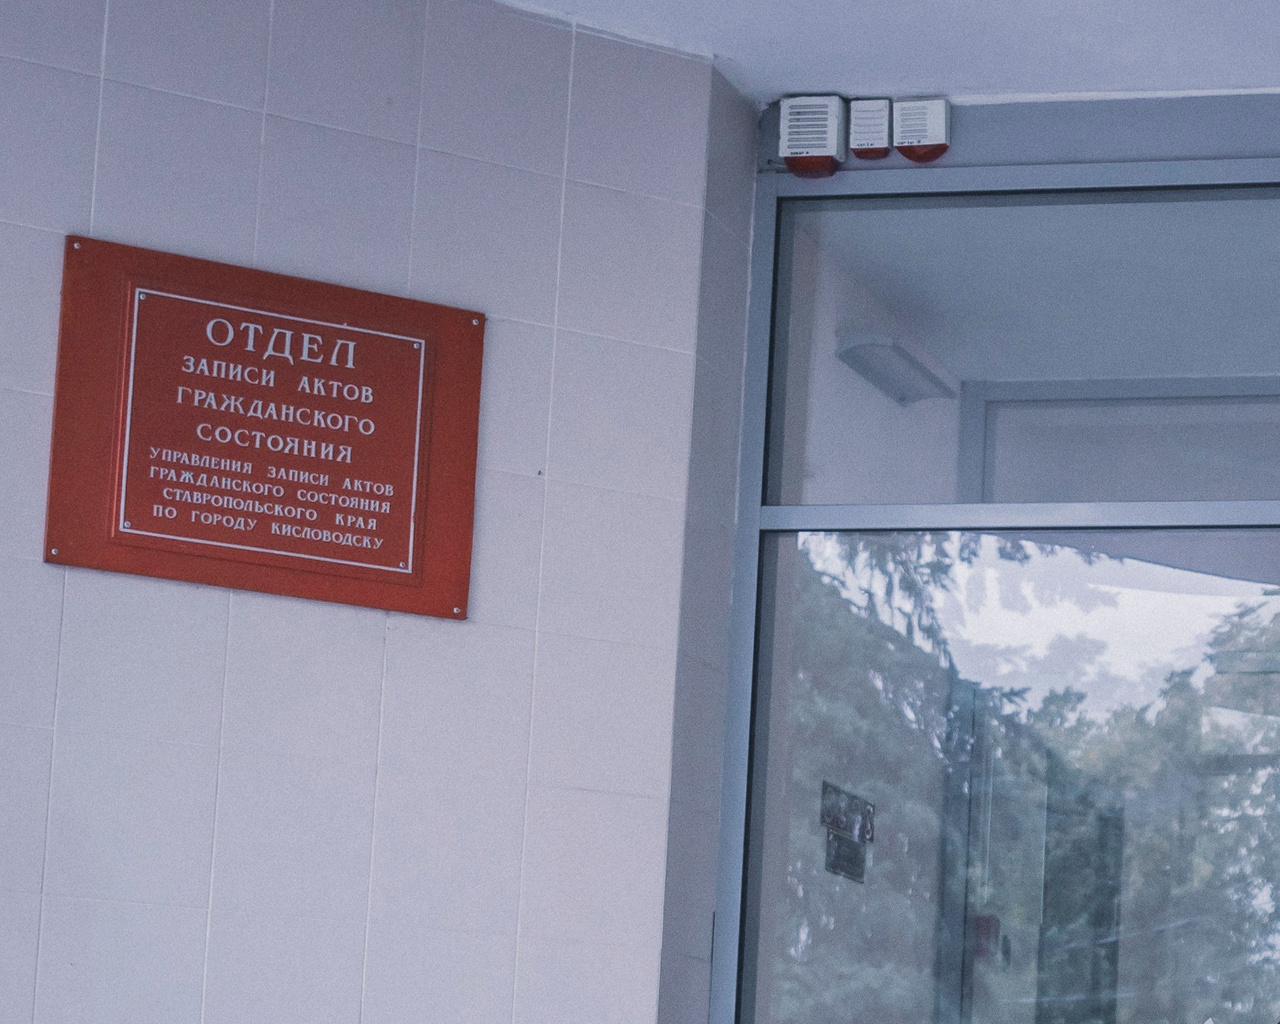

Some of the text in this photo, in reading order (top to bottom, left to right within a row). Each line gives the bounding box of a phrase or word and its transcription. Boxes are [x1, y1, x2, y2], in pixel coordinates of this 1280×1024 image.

[205, 317, 357, 369] ОТДЕЛ
[181, 355, 374, 404] ЗАПИСИ АКТОВ
[176, 386, 375, 435] ГРАЖДАНСКОГО
[196, 423, 353, 464] СОСТОЯНИЯ
[150, 447, 394, 497] УПРАВЛЕНИЯ ЗАПИСИ АКТОВ
[150, 466, 391, 514] ГРАЖДАНСКОГО СОСТОЯНИЯ
[152, 504, 384, 550] ПО ГОРОДУ КИСЛОВОДСКУ
[163, 488, 377, 531] СТАВРОПОЛЬСКОГО КРАЯ
